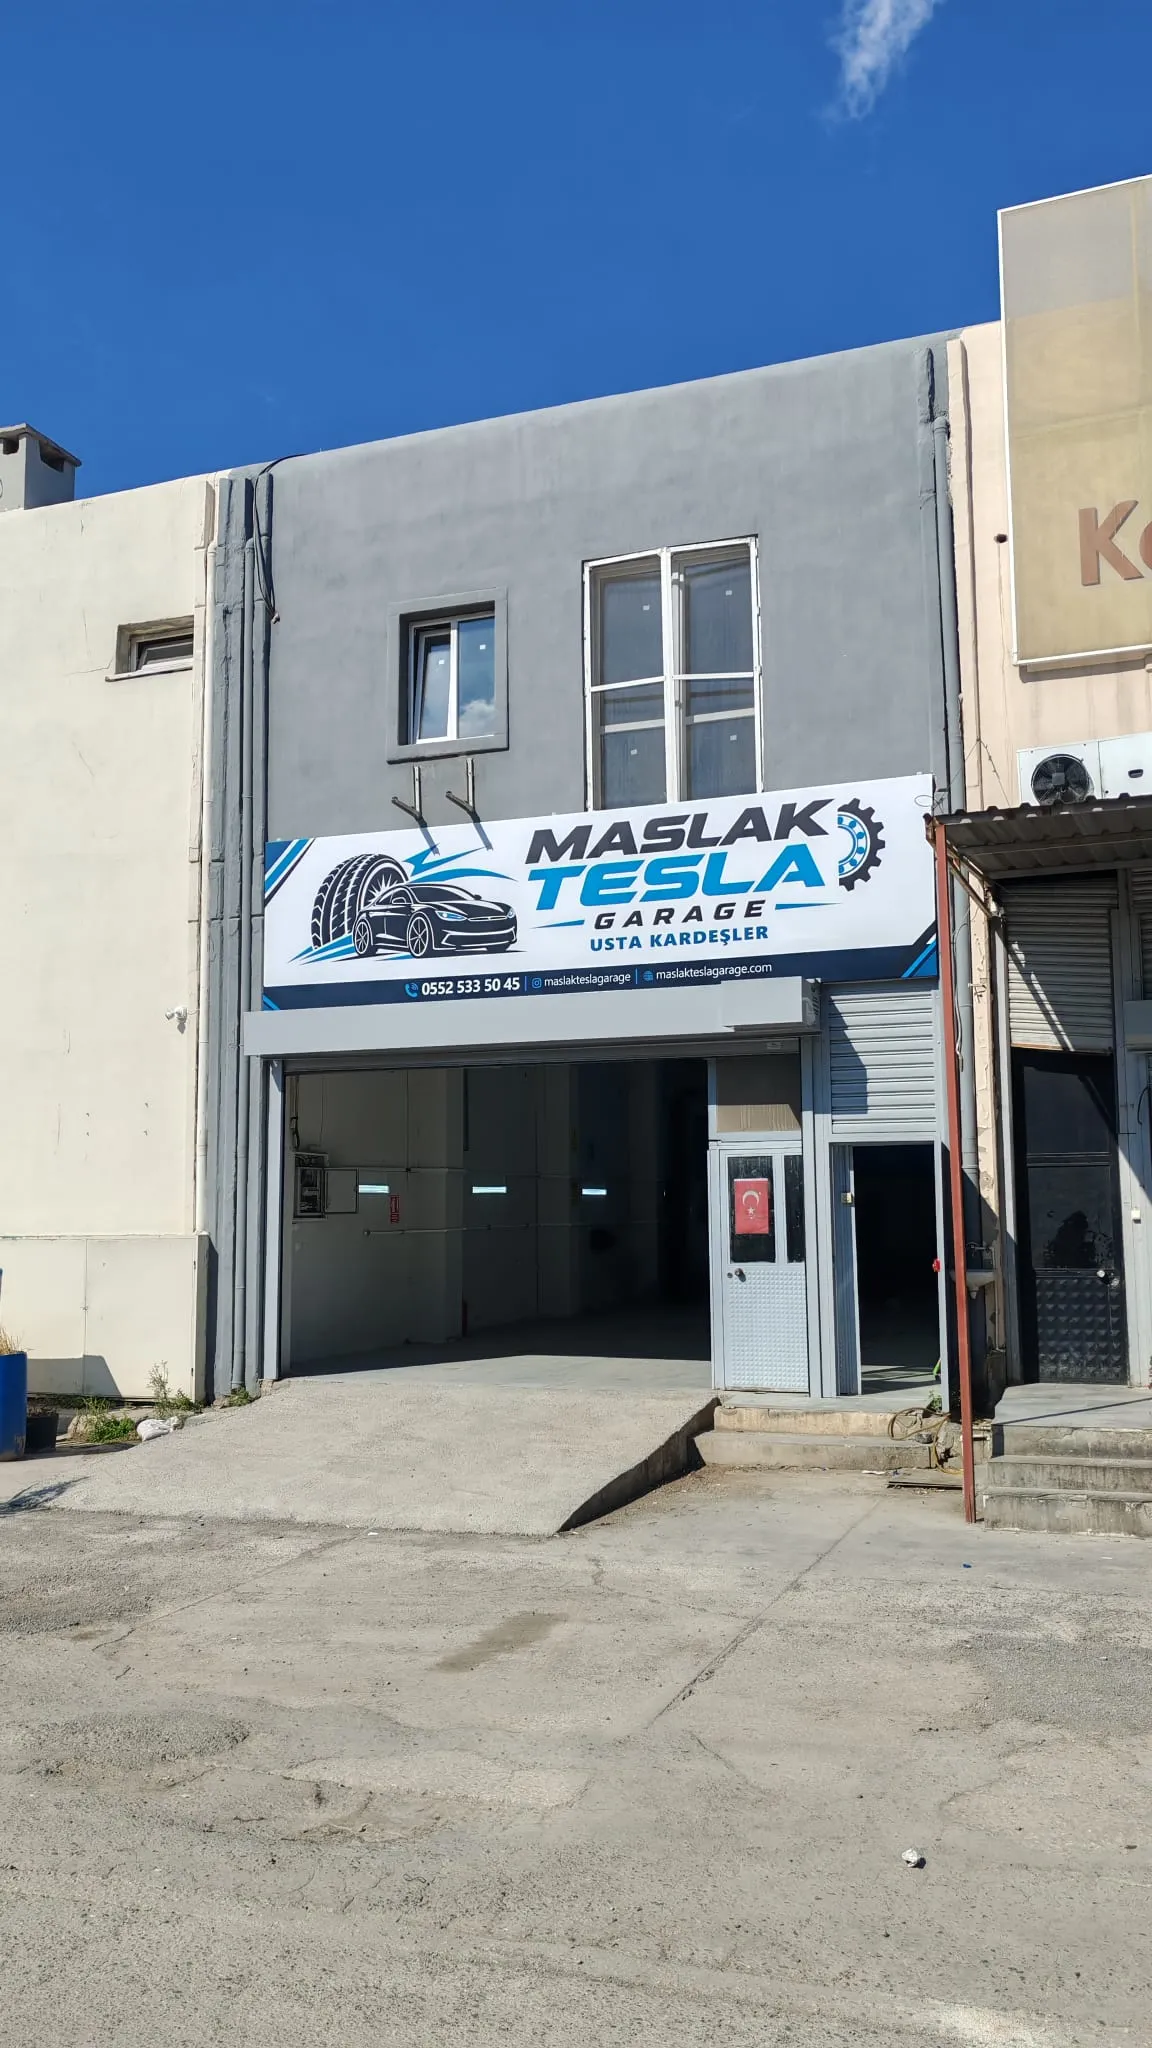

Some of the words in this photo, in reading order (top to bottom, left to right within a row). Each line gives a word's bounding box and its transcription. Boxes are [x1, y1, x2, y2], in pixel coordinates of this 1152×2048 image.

[1078, 500, 1152, 587] K
[525, 798, 835, 864] MASLAK
[528, 843, 825, 911] TESLA
[594, 899, 766, 930] GARAGE
[590, 936, 642, 952] USTA
[650, 926, 768, 946] KARDEŞLER
[544, 973, 631, 986] maslakteslagarage
[656, 963, 772, 980] maslakteslagarage.com
[421, 981, 454, 996] 0552
[457, 979, 481, 994] 533
[484, 978, 501, 992] 50
[503, 977, 520, 991] 45
